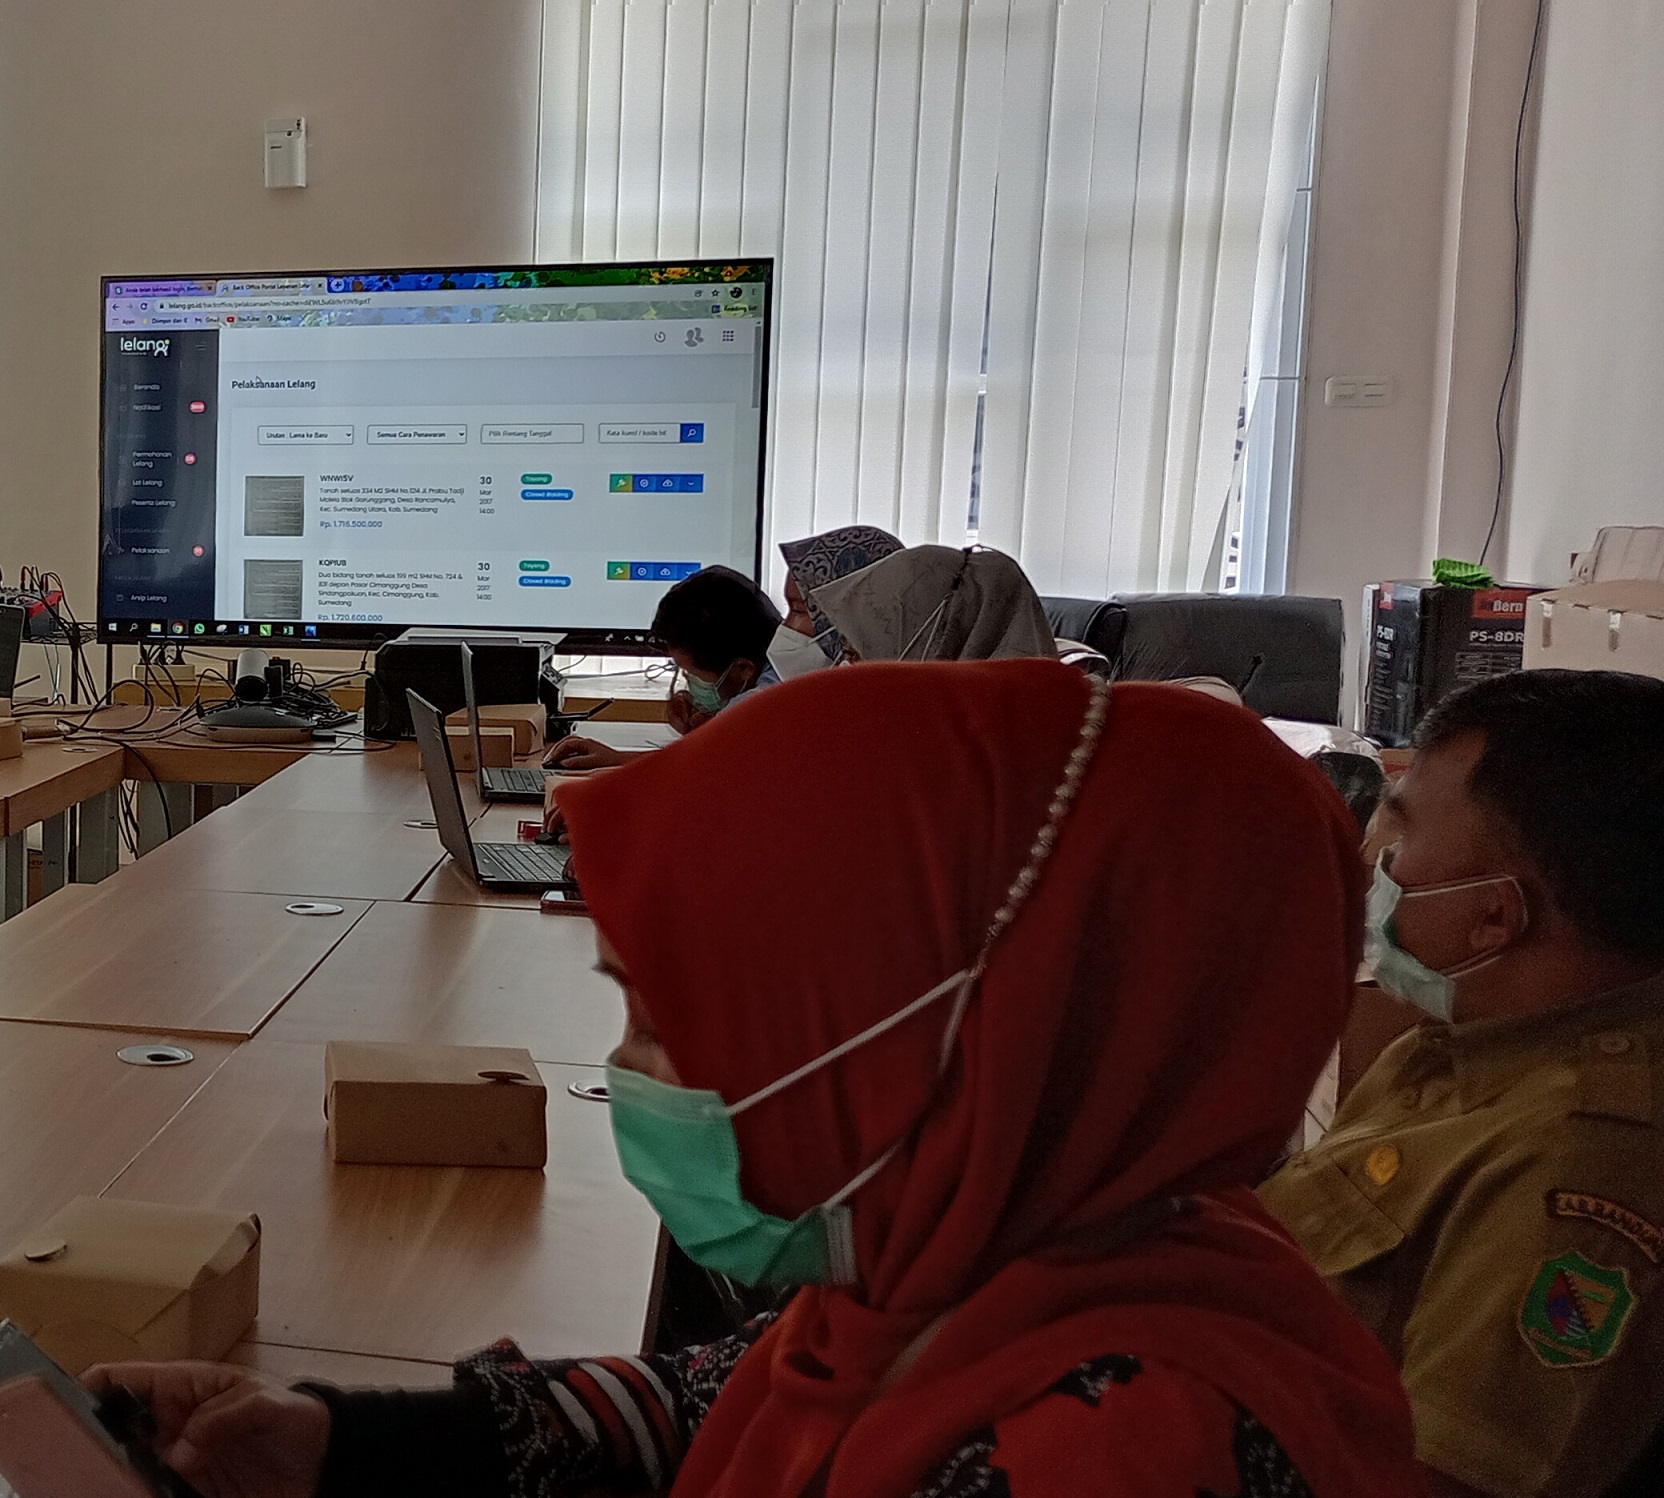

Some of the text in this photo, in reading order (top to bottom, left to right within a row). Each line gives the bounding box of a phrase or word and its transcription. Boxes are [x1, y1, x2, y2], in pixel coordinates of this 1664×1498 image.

[232, 380, 316, 390] Pelaksanaan Lelang
[479, 476, 492, 485] 30
[477, 562, 490, 571] 30
[1469, 630, 1524, 643] PS-8DR
